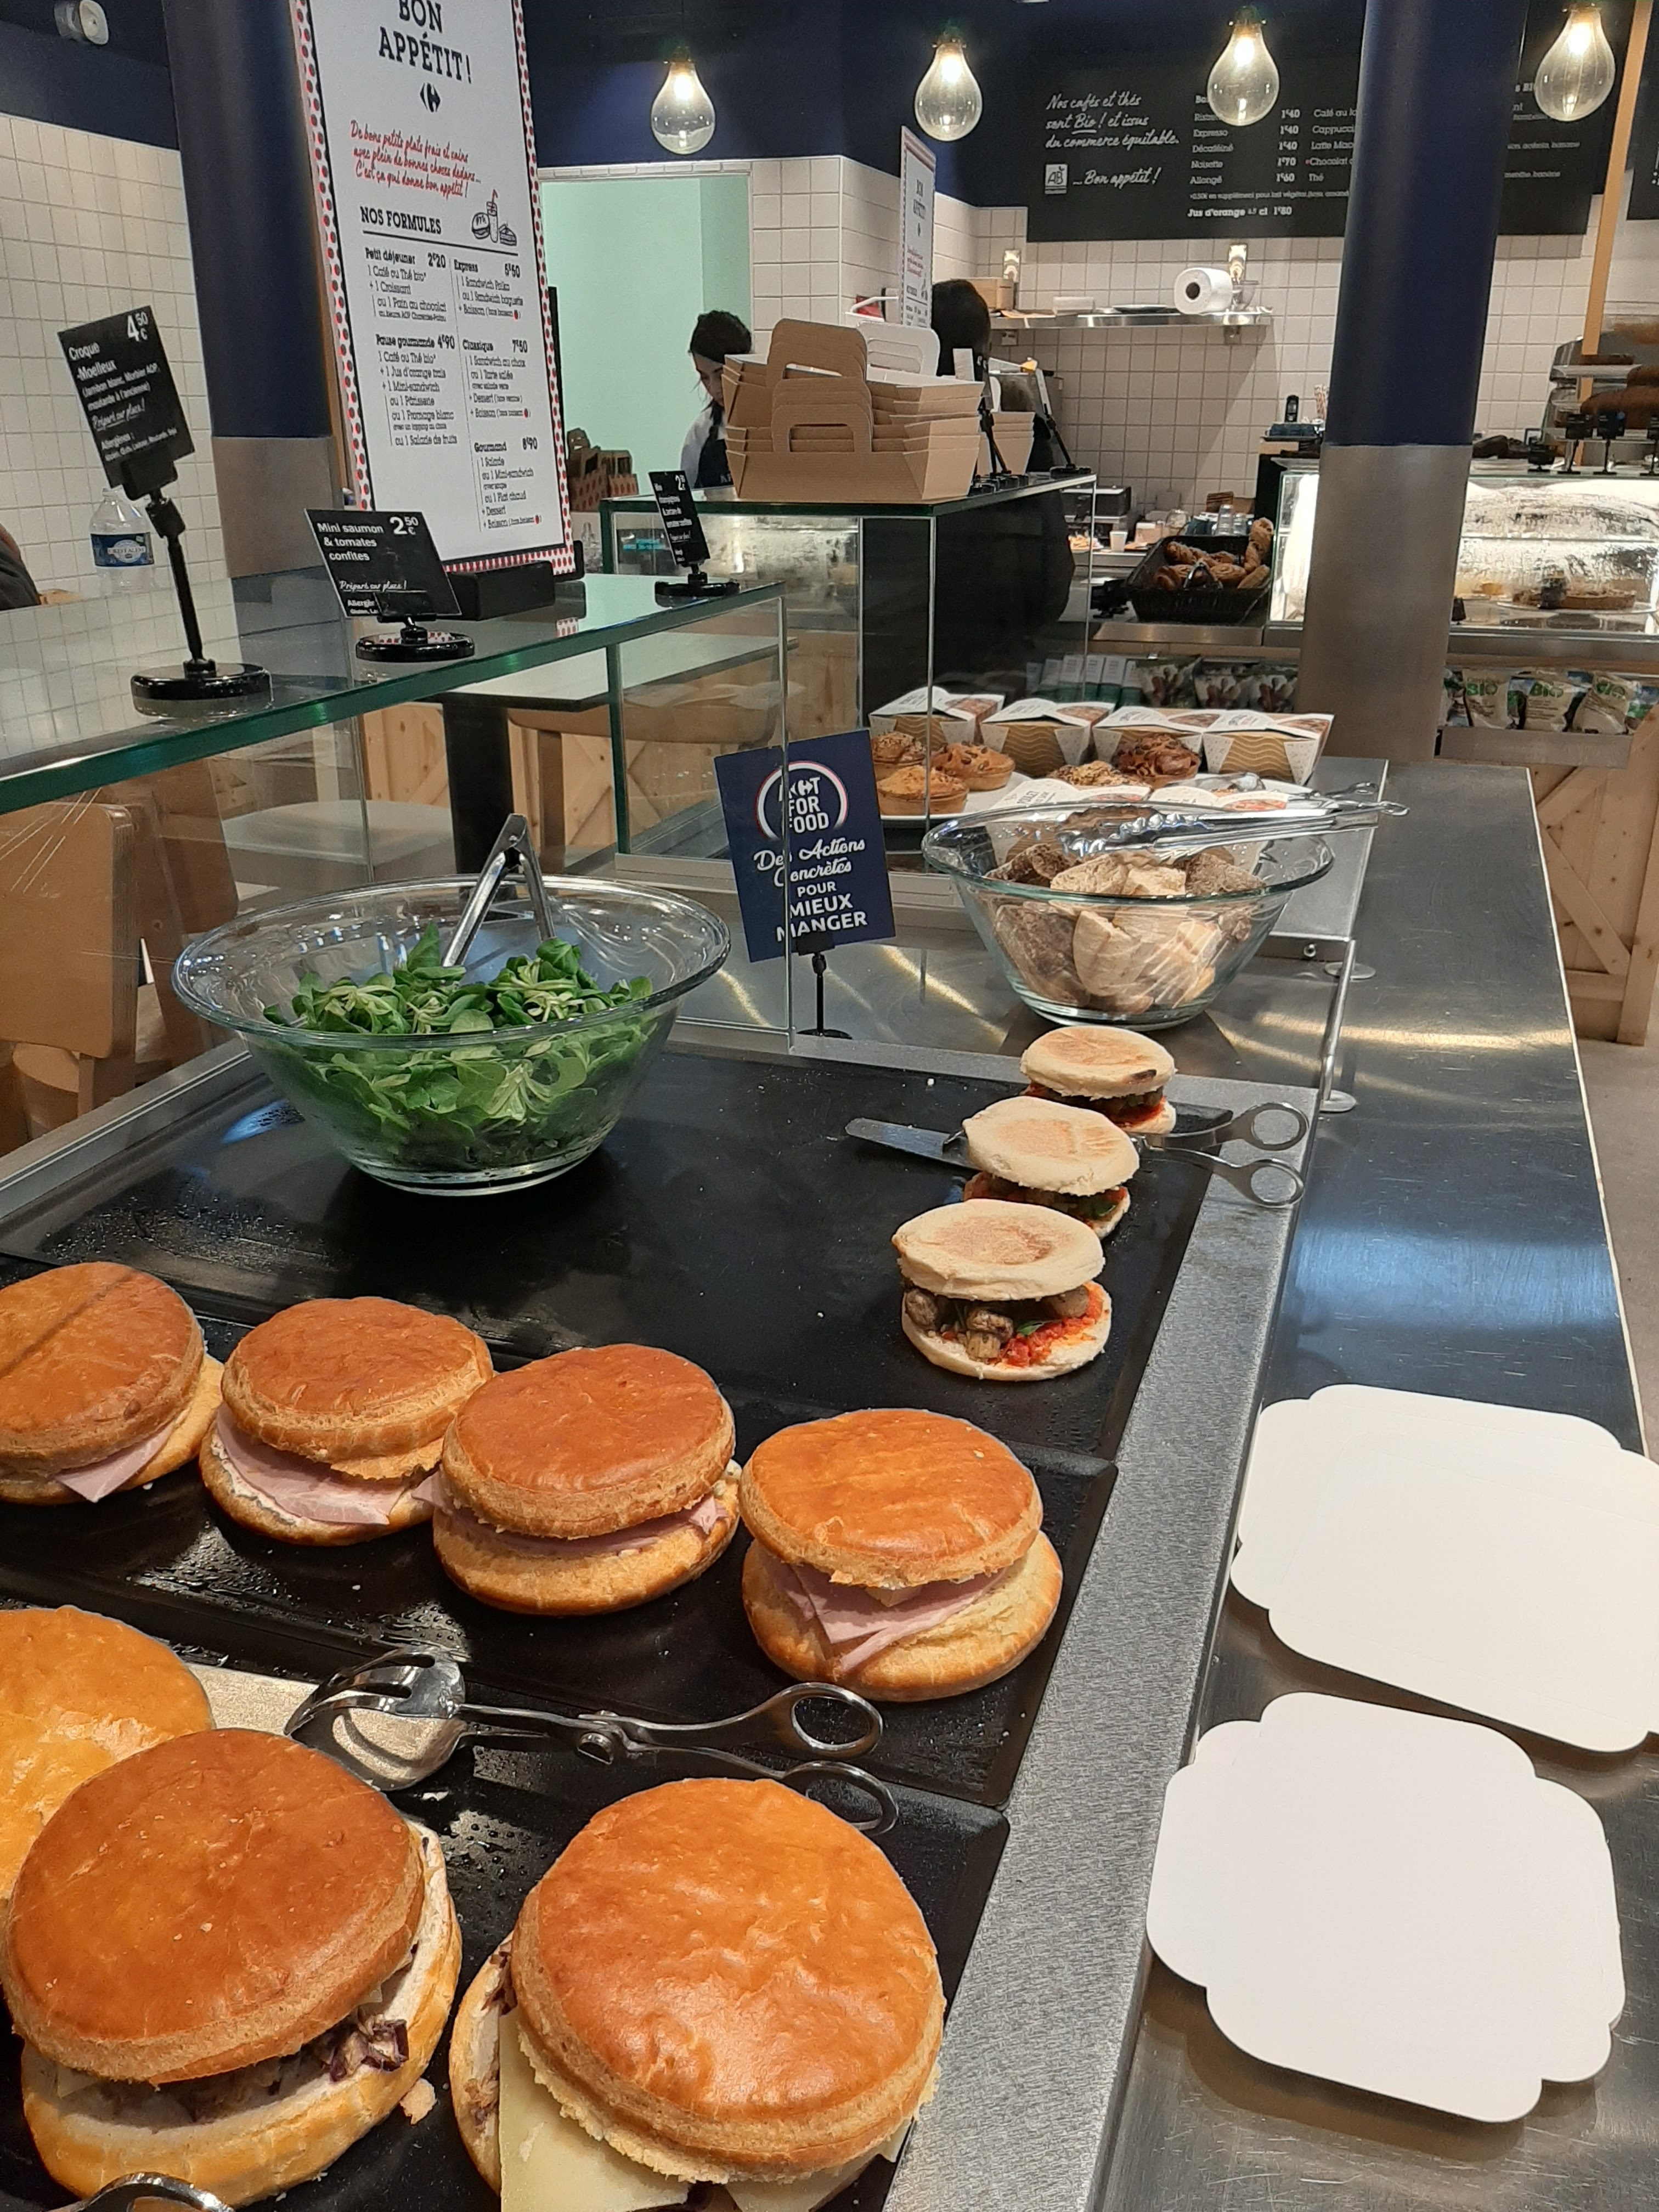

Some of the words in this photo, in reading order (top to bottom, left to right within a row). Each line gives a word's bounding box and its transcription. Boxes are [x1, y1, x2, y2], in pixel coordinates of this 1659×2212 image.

[399, 0, 443, 33] BON
[1046, 93, 1069, 110] Nos
[1070, 92, 1101, 111] cafés
[1103, 91, 1117, 107] et
[1118, 91, 1142, 106] thés
[1046, 114, 1073, 129] sont
[1074, 113, 1097, 129] Bio
[1108, 111, 1122, 127] et
[1121, 114, 1149, 127] issus
[1313, 108, 1334, 117] Café
[1312, 125, 1355, 135] Cappucci
[351, 120, 363, 138] De
[364, 123, 382, 143] bons
[382, 129, 404, 151] petits
[404, 135, 423, 155] plats
[425, 139, 441, 159] frais
[443, 141, 450, 159] et
[451, 148, 469, 163] sains
[1045, 134, 1062, 148] du
[1064, 136, 1120, 147] commerce
[353, 146, 370, 159] avec
[371, 146, 392, 166] plein
[394, 150, 402, 166] de
[404, 153, 428, 172] bonnes
[430, 157, 451, 178] choses
[1310, 157, 1348, 166] Chocolat
[356, 159, 375, 179] C'est
[376, 169, 385, 183] ça
[387, 170, 400, 188] qui
[402, 171, 424, 189] donne
[426, 174, 438, 192] bon
[1110, 167, 1153, 189] appétit
[1189, 175, 1222, 185] Allongé
[1308, 172, 1324, 182] Thé
[1188, 208, 1203, 217] Jus
[1204, 208, 1246, 218] d'orange
[1259, 207, 1268, 216] cl
[360, 206, 384, 225] NOS
[386, 210, 442, 235] FORMULES
[365, 247, 382, 261] Petit
[383, 249, 415, 265] déjeuner
[373, 265, 389, 278] Café
[391, 269, 399, 279] ou
[400, 268, 413, 280] Thé
[454, 259, 478, 273] Express
[377, 298, 386, 307] ou
[375, 333, 396, 346] Pause
[398, 336, 435, 349] gourmande
[462, 338, 494, 353] Classique
[68, 341, 101, 360] Croque
[383, 351, 399, 363] Café
[401, 353, 409, 363] ou
[410, 352, 422, 364] Thé
[392, 365, 402, 377] Jus
[474, 441, 507, 453] Gourmand
[317, 522, 341, 533] Mini
[342, 524, 384, 533] saumon
[323, 536, 333, 547] &
[335, 538, 377, 547] tomates
[329, 551, 370, 561] confites
[339, 579, 369, 592] Préparé
[382, 580, 403, 592] place
[789, 796, 821, 817] FOR
[789, 812, 829, 833] OOD
[799, 837, 866, 860] Actions
[774, 857, 852, 887] Concrètes
[797, 881, 837, 898] POUR
[790, 893, 854, 918] MIEUX
